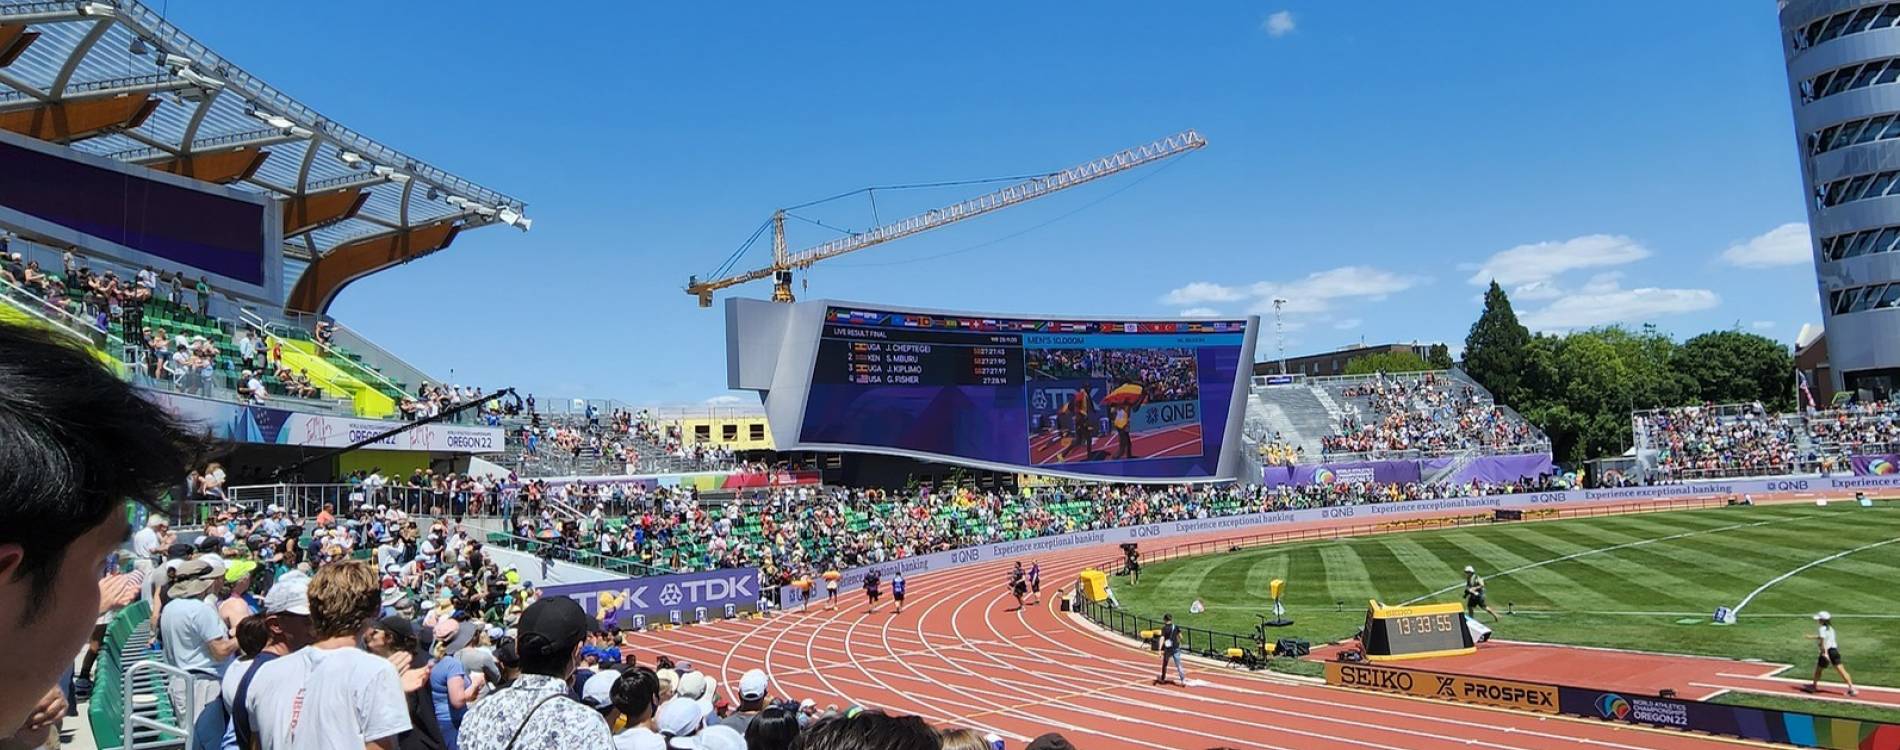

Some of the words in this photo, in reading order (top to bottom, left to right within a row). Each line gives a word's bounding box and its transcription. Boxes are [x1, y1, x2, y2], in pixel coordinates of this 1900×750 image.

[834, 328, 846, 336] LIVE
[847, 329, 869, 337] RESULT
[870, 330, 887, 338] FINAL
[893, 345, 931, 353] CHEPTEGEI
[868, 354, 880, 362] KEN
[894, 355, 918, 363] MBURU
[895, 376, 919, 384] FISHER
[1160, 404, 1195, 422] QNB
[1585, 491, 1635, 500] Experience
[1636, 487, 1690, 497] exceptional
[1692, 484, 1732, 494] banking
[1778, 481, 1808, 490] QNB
[1832, 479, 1891, 488] Experience
[1372, 504, 1416, 514] Experience
[1417, 501, 1464, 511] exceptional
[1466, 498, 1500, 507] banking
[1540, 494, 1566, 503] QNB
[1176, 521, 1216, 532] Experience
[1218, 516, 1262, 529] exceptional
[1263, 512, 1295, 523] banking
[1331, 508, 1354, 518] QNB
[994, 541, 1032, 556] Experience
[1033, 534, 1074, 550] exceptional
[1075, 532, 1104, 544] banking
[1138, 525, 1160, 537] QNB
[902, 559, 928, 575] banking
[958, 550, 980, 563] QNB
[682, 575, 752, 602] TDK
[1396, 615, 1452, 635] 13:33:55
[1340, 666, 1413, 691] SEIKO
[1464, 682, 1553, 707] PROSPEX
[1632, 699, 1653, 707] WORLD
[1655, 702, 1686, 711] ATHLETICS
[1633, 705, 1687, 716] CHAMPIONSHIPS
